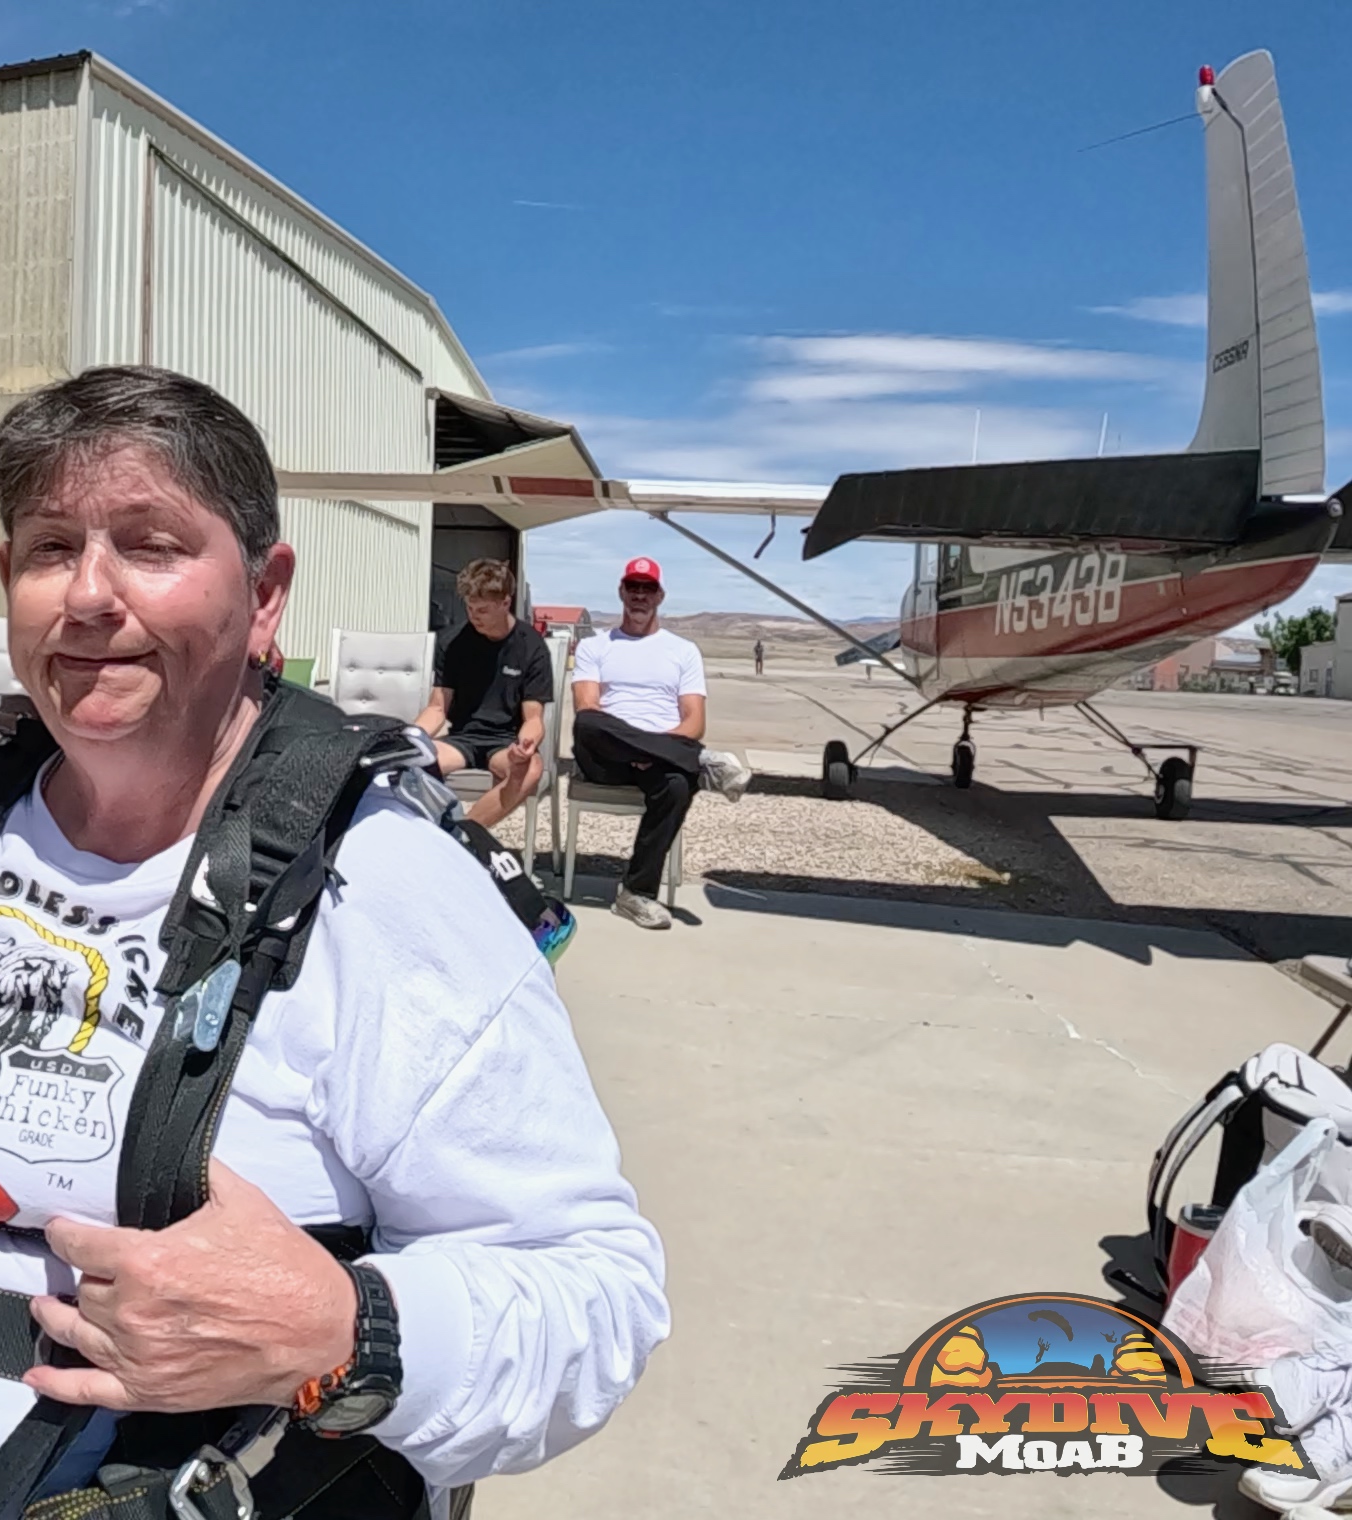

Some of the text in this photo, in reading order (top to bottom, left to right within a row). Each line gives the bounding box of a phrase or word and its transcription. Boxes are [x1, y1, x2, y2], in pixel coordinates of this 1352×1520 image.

[994, 552, 1127, 636] N5343B
[29, 1059, 87, 1078] USDA
[9, 1074, 97, 1114] Funky
[18, 1128, 57, 1149] GRADE
[46, 1172, 74, 1192] TM
